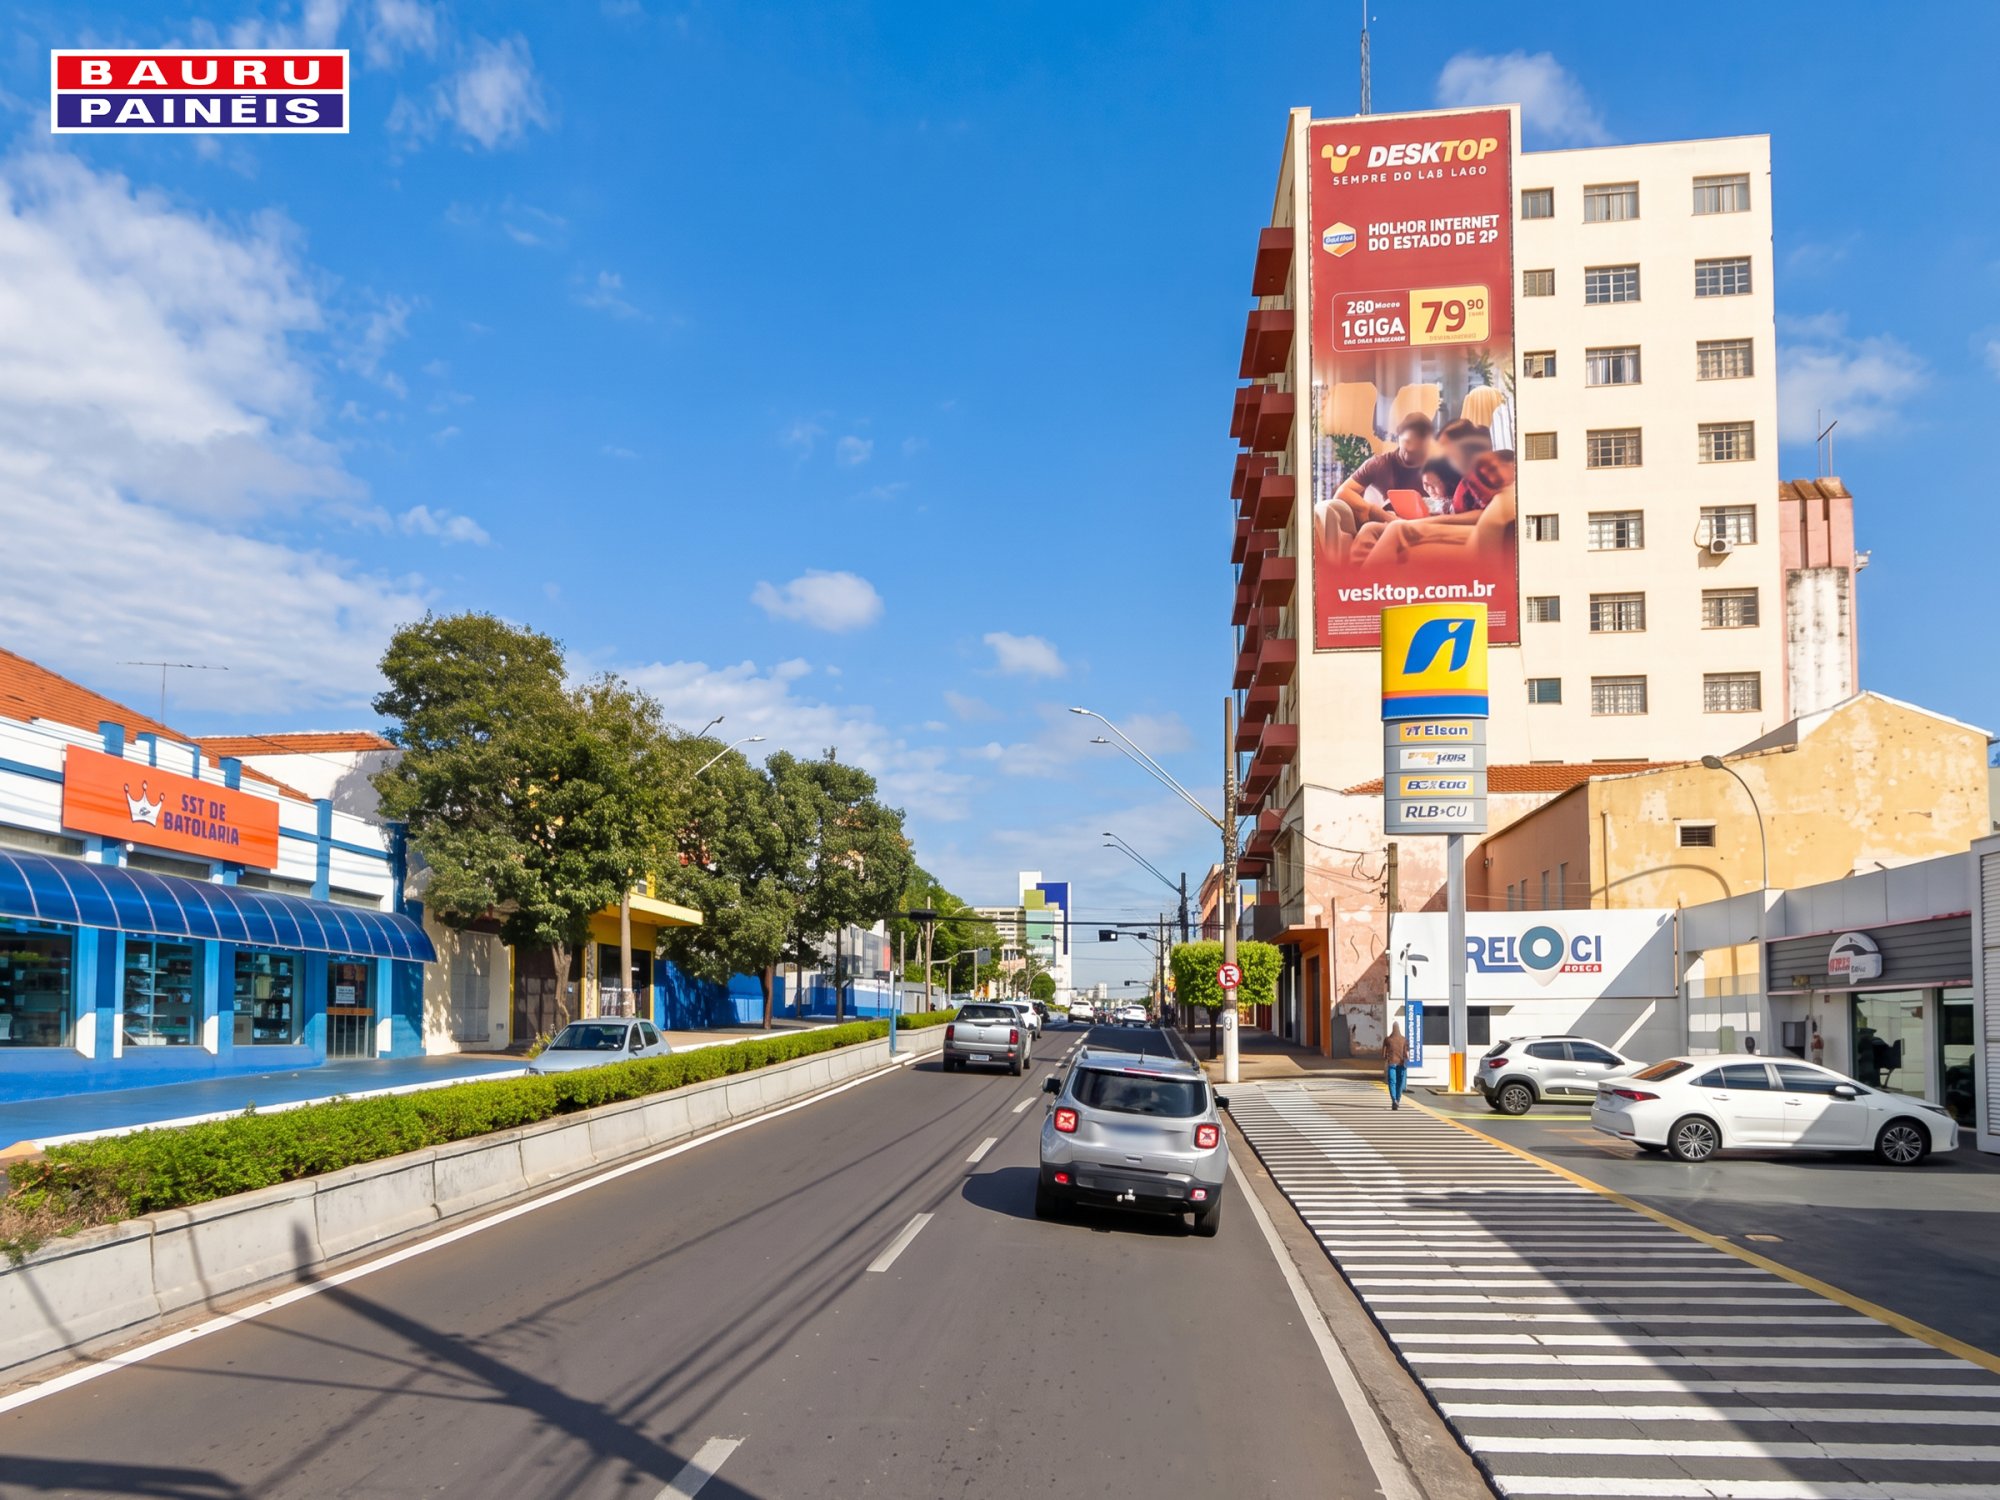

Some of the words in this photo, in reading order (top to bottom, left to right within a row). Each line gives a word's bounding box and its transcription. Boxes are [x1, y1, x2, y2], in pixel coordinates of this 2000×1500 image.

[1367, 137, 1499, 169] DESKTOP
[1332, 173, 1388, 186] SEMPRE
[1393, 171, 1412, 182] DO
[1450, 165, 1488, 177] LAGO
[1368, 219, 1427, 236] HOLHOR
[1430, 214, 1500, 231] INTERNET
[1368, 237, 1390, 252] DO
[1393, 233, 1452, 250] ESTADO
[1455, 231, 1475, 246] DE
[1479, 229, 1499, 244] 2P
[1421, 299, 1467, 334] 79
[1338, 579, 1497, 604] vesktop.com.br
[181, 793, 205, 816] SST
[209, 801, 226, 822] DE
[163, 811, 240, 846] BATOLARIA
